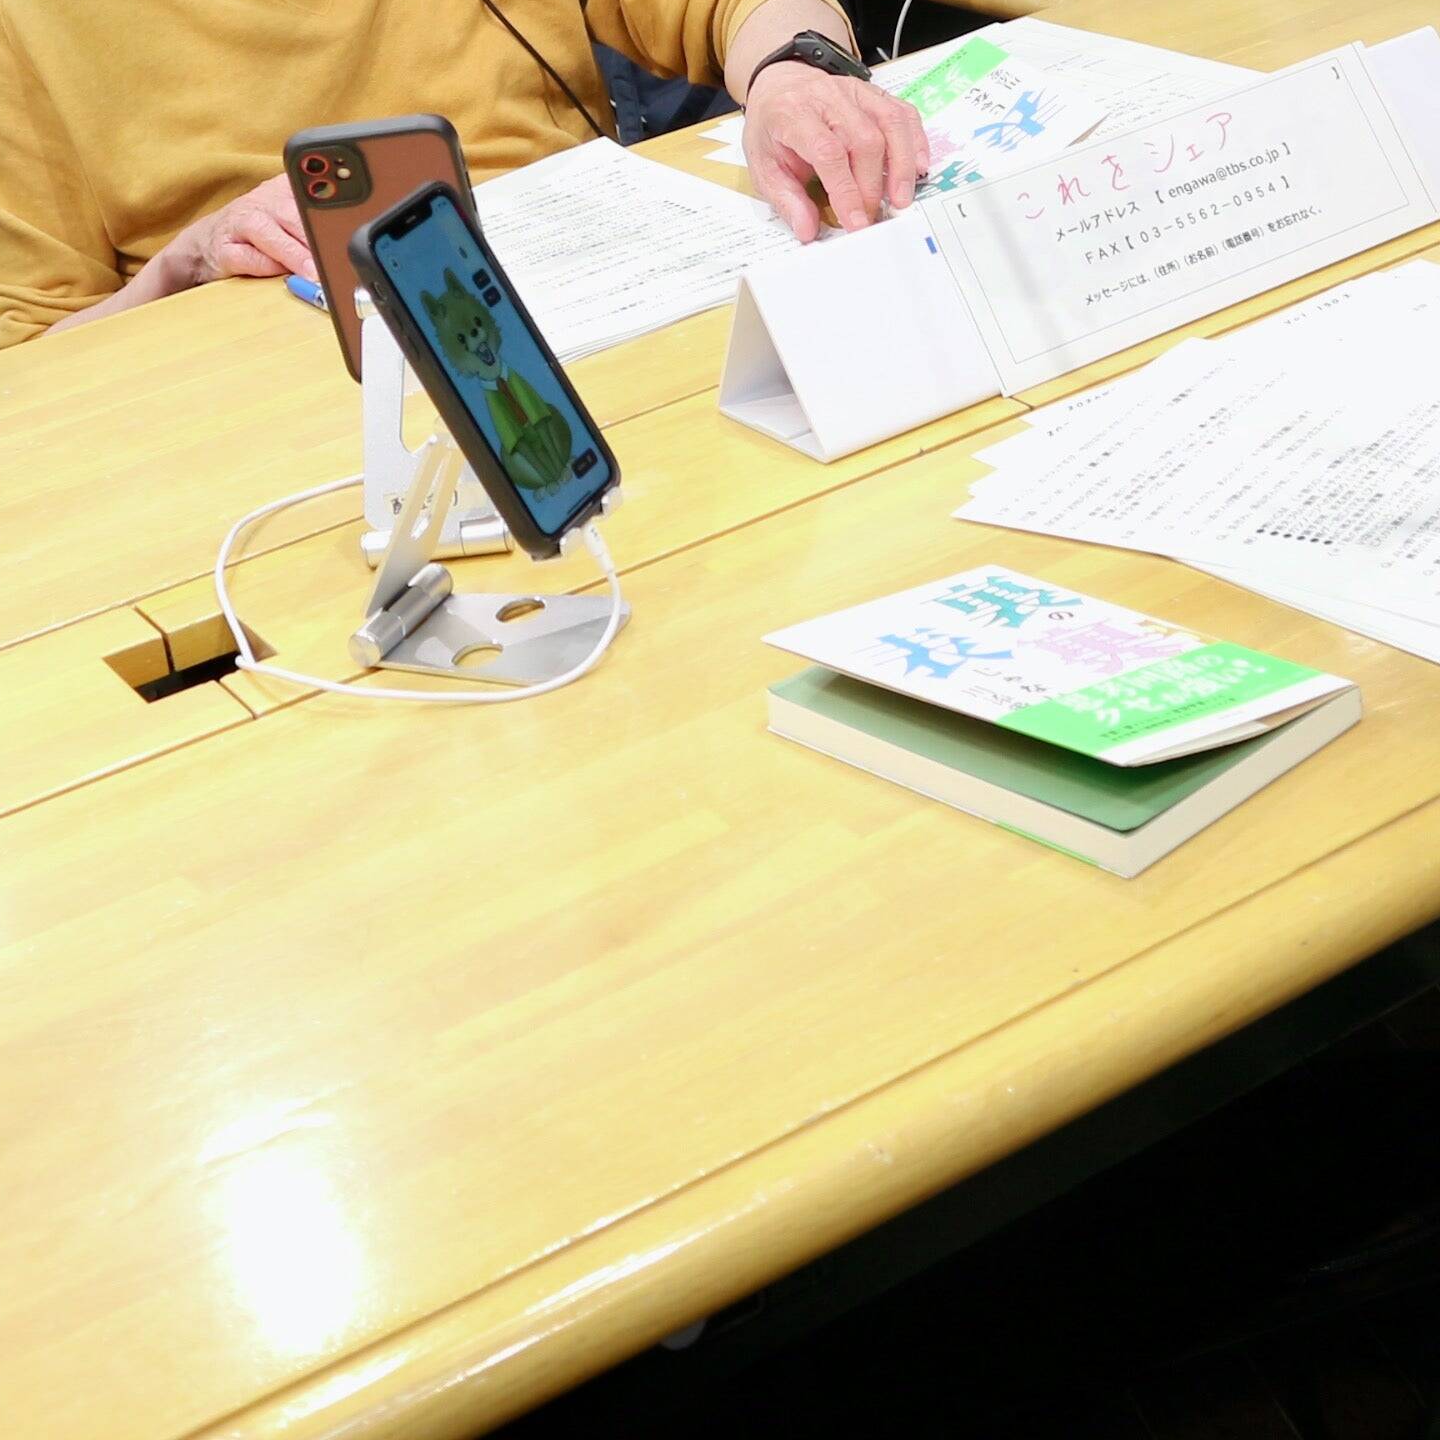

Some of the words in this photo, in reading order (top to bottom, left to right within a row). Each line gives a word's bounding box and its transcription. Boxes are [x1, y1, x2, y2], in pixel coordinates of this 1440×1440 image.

[1056, 200, 1140, 242] メールアドレス
